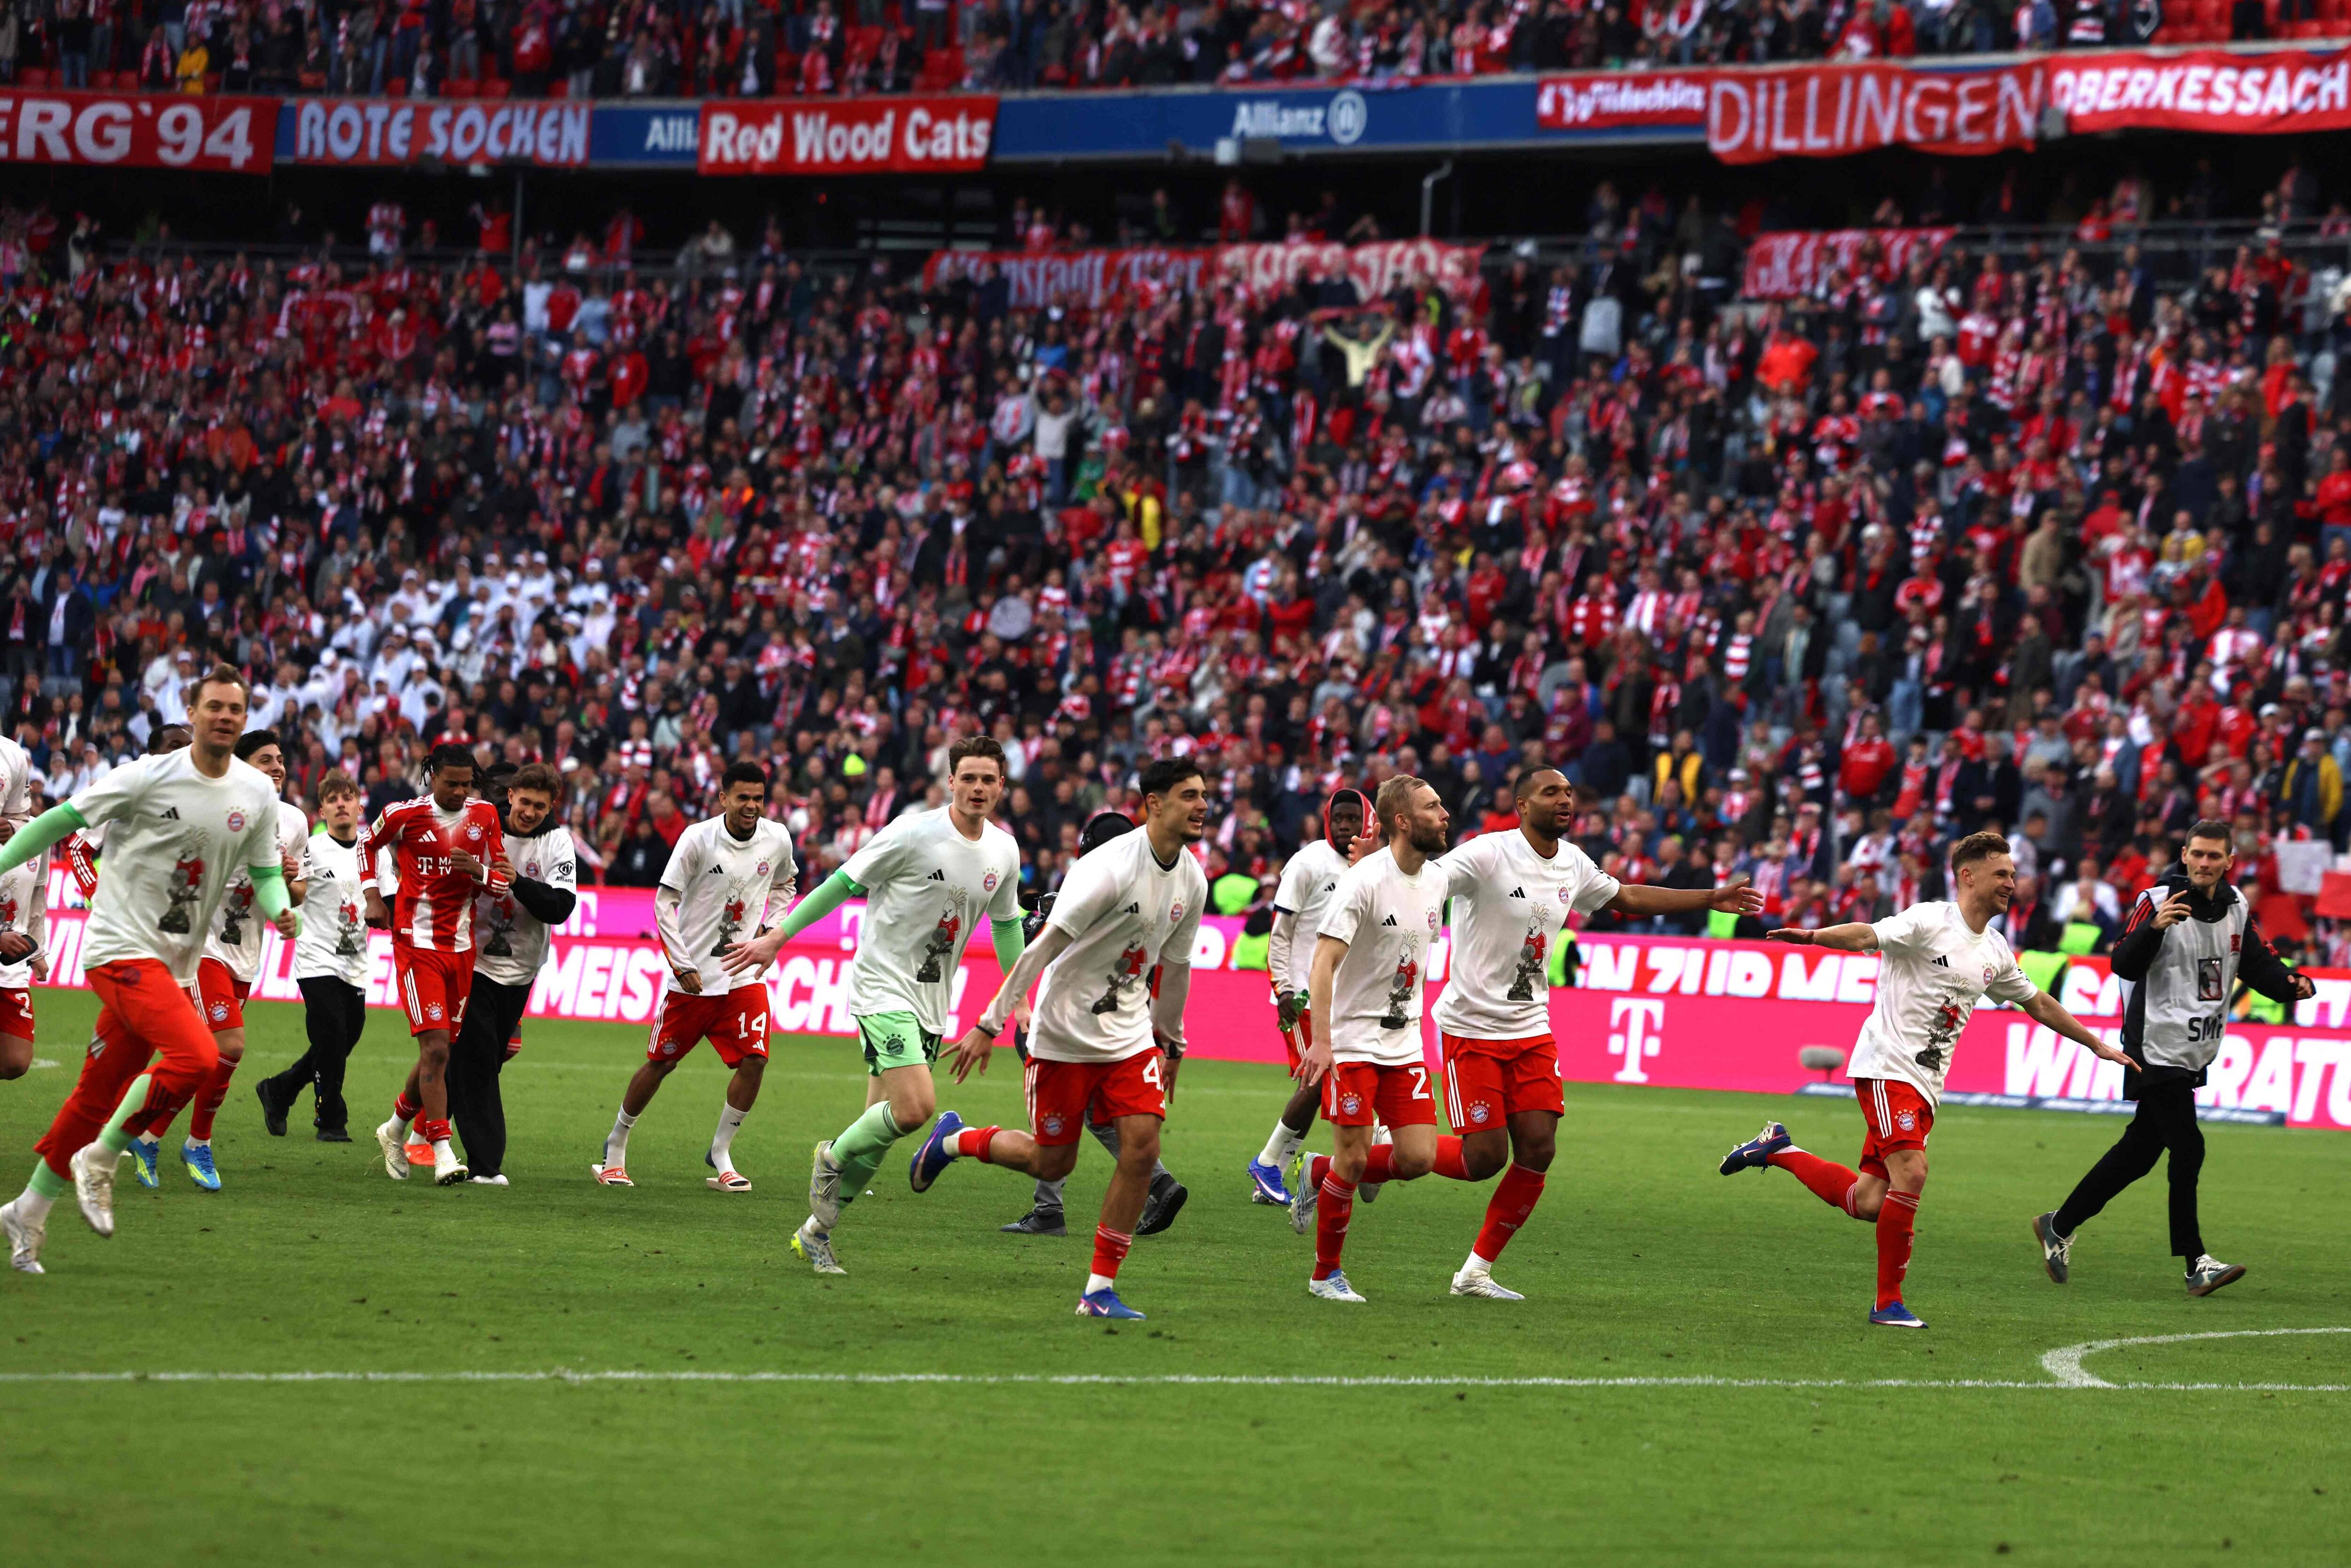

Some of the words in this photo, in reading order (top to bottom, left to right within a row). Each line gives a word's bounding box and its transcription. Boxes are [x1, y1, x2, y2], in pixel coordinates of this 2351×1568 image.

[2052, 60, 2349, 116] OBERKESSACH
[1231, 101, 1326, 138] Allianz
[1708, 68, 2044, 153] DILLINGEN
[297, 102, 416, 161] ROTE
[425, 104, 590, 163] SOCKEN
[645, 116, 700, 151] Alli
[706, 112, 783, 163] Red
[793, 109, 897, 162] Wood
[904, 108, 992, 159] Cats
[439, 855, 480, 866] MATA
[439, 866, 451, 875] TV
[555, 875, 574, 884] Allianz
[738, 1011, 767, 1040] 14
